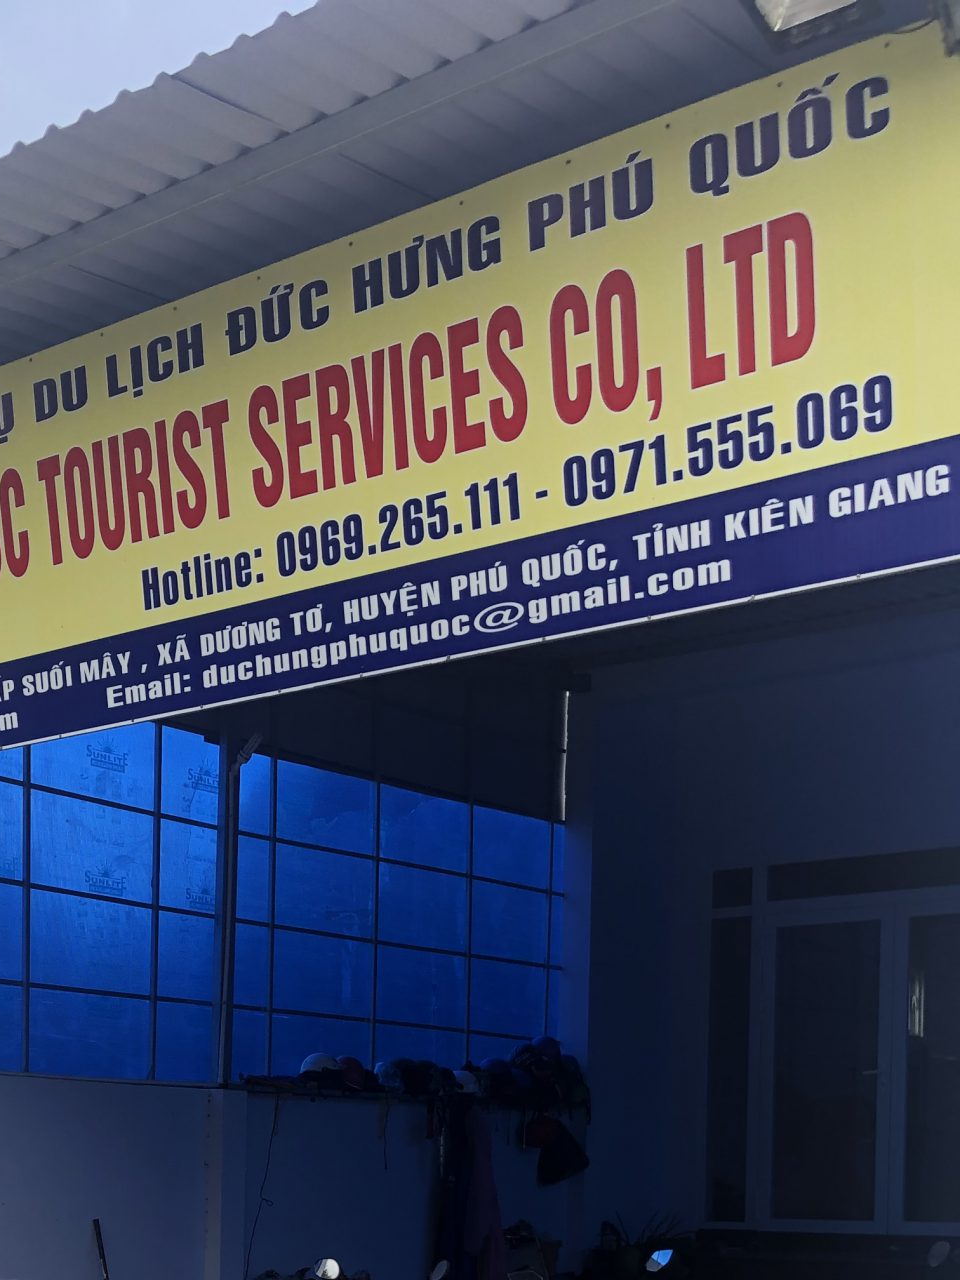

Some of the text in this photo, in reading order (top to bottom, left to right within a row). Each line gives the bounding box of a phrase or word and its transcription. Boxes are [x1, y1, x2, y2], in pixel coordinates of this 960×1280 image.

[33, 365, 88, 423] DU
[104, 322, 205, 398] LỊCH
[224, 279, 330, 356] ĐỨC
[351, 215, 502, 314] HƯNG
[527, 151, 655, 252] PHÚ
[688, 73, 891, 197] QUỐC
[36, 399, 231, 565] TOURIST
[248, 305, 529, 508] SERVICES
[549, 268, 663, 426] CO,
[685, 212, 816, 391] LTD
[141, 546, 264, 611] Hotline:
[276, 472, 521, 577] 0969.265.111
[562, 374, 893, 507] 0971.555.069
[21, 660, 73, 694] SUỐI
[80, 650, 131, 684] MÂY
[157, 634, 191, 666] XÃ
[200, 617, 280, 657] DƯƠNG
[289, 602, 332, 635] TƠ,
[342, 572, 441, 625] HUYỆN
[450, 560, 508, 602] PHÚ
[522, 538, 619, 578] QUỐC,
[633, 524, 711, 562] TỈNH
[723, 493, 814, 542] KIÊN
[827, 463, 951, 519] GIANG
[106, 556, 732, 711] Email: duchungphuquoc@gmail.com
